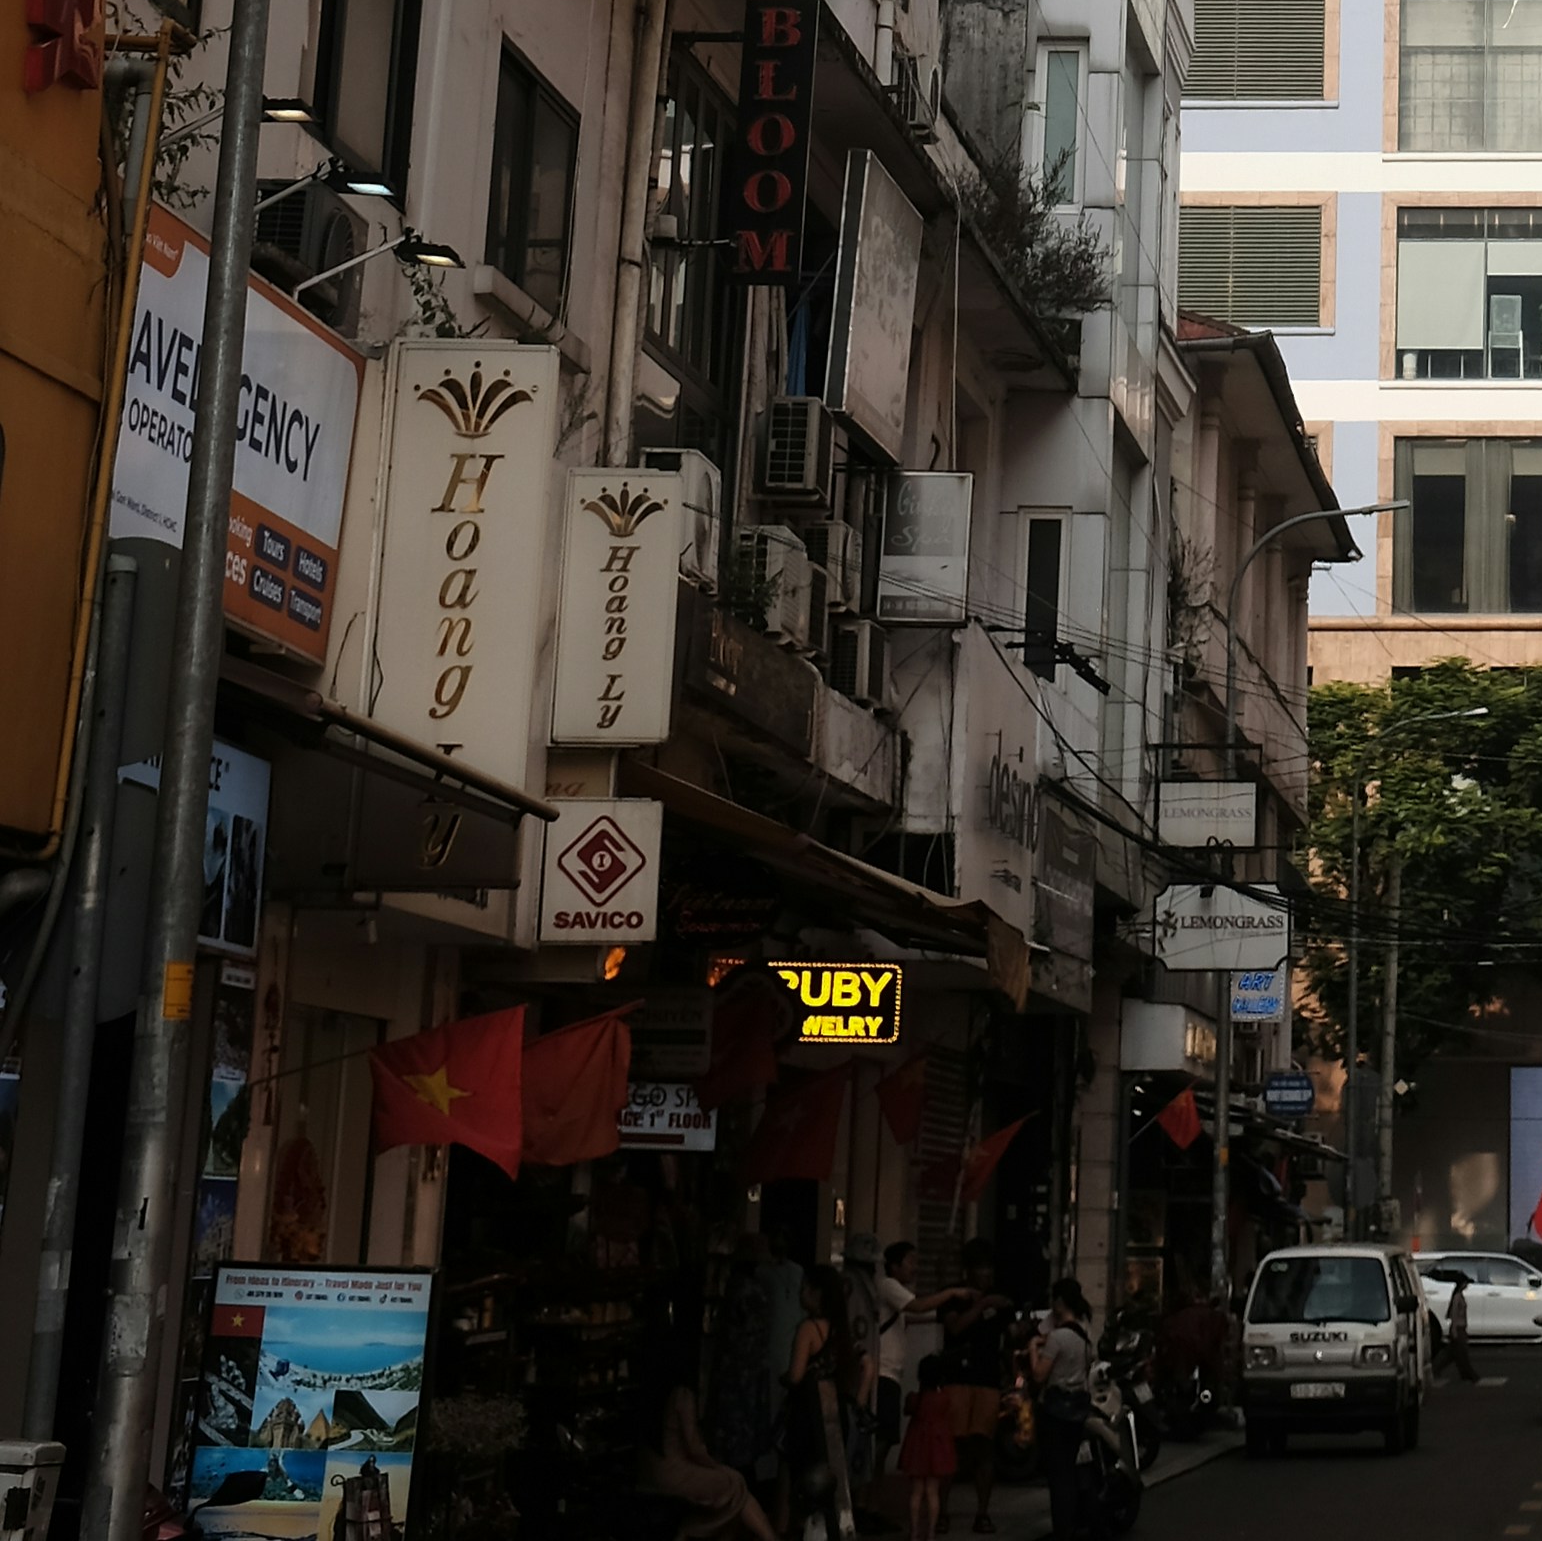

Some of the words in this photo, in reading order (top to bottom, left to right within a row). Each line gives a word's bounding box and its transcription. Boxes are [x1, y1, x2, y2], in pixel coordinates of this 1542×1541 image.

[732, 6, 802, 274] BLOOM
[261, 531, 286, 561] Tours
[298, 551, 324, 584] Hotels
[252, 569, 283, 604] Cruises
[429, 452, 505, 720] Hoang
[600, 546, 640, 661] Hoang
[597, 674, 625, 729] Ly
[1163, 807, 1252, 818] LEMONGRASS
[553, 911, 644, 929] SAVICO
[1180, 915, 1284, 929] LEMONGRASS
[1238, 972, 1275, 991] ART
[669, 1111, 711, 1129] FLOOR
[226, 1274, 246, 1285] From
[271, 1276, 280, 1286] to
[325, 1278, 350, 1289] Travel
[351, 1279, 372, 1290] Made
[394, 1281, 405, 1291] for
[408, 1281, 422, 1291] You
[1290, 1331, 1347, 1343] SUZUKI
